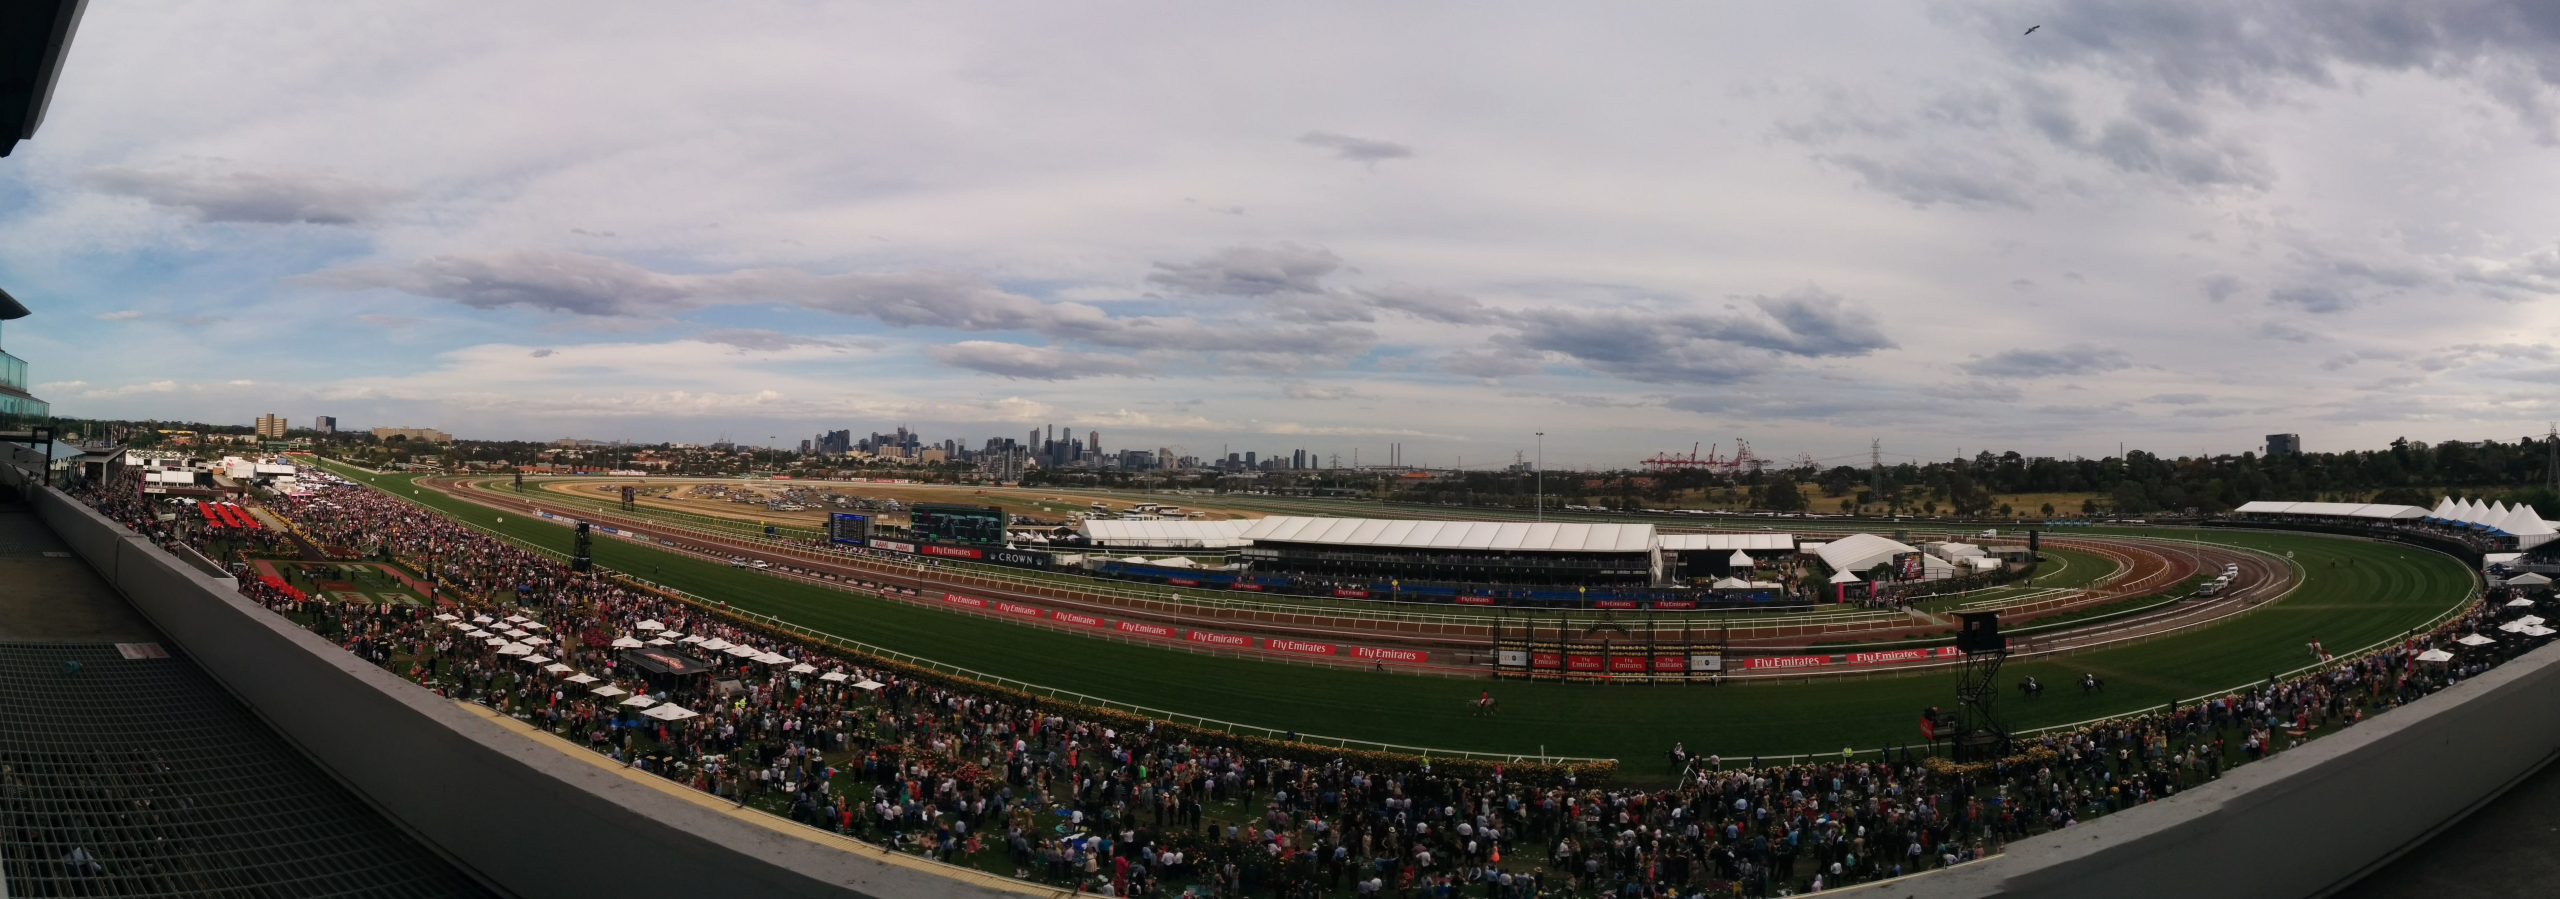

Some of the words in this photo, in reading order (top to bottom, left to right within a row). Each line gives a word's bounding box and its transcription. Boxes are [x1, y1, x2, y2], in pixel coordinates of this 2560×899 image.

[932, 546, 942, 555] Fly
[942, 548, 970, 556] Emirates
[998, 552, 1032, 564] CROWN
[948, 594, 957, 603] Fly
[958, 596, 980, 607] Emirates
[1000, 604, 1010, 613] Fly
[1010, 605, 1036, 616] Emirates
[1056, 612, 1067, 623] Fly
[1068, 614, 1096, 625] Emirates
[1122, 622, 1134, 633] Fly
[1135, 624, 1166, 635] Emirates
[1193, 632, 1206, 643] Fly
[1208, 634, 1243, 645] Emirates
[1272, 640, 1287, 652] Fly
[1288, 642, 1325, 653] Emirates
[1359, 648, 1375, 660] Fly
[1376, 649, 1416, 660] Emirates
[1857, 653, 1873, 663] Fly
[1874, 650, 1918, 660] Emirates
[1774, 656, 1819, 666] Emirates
